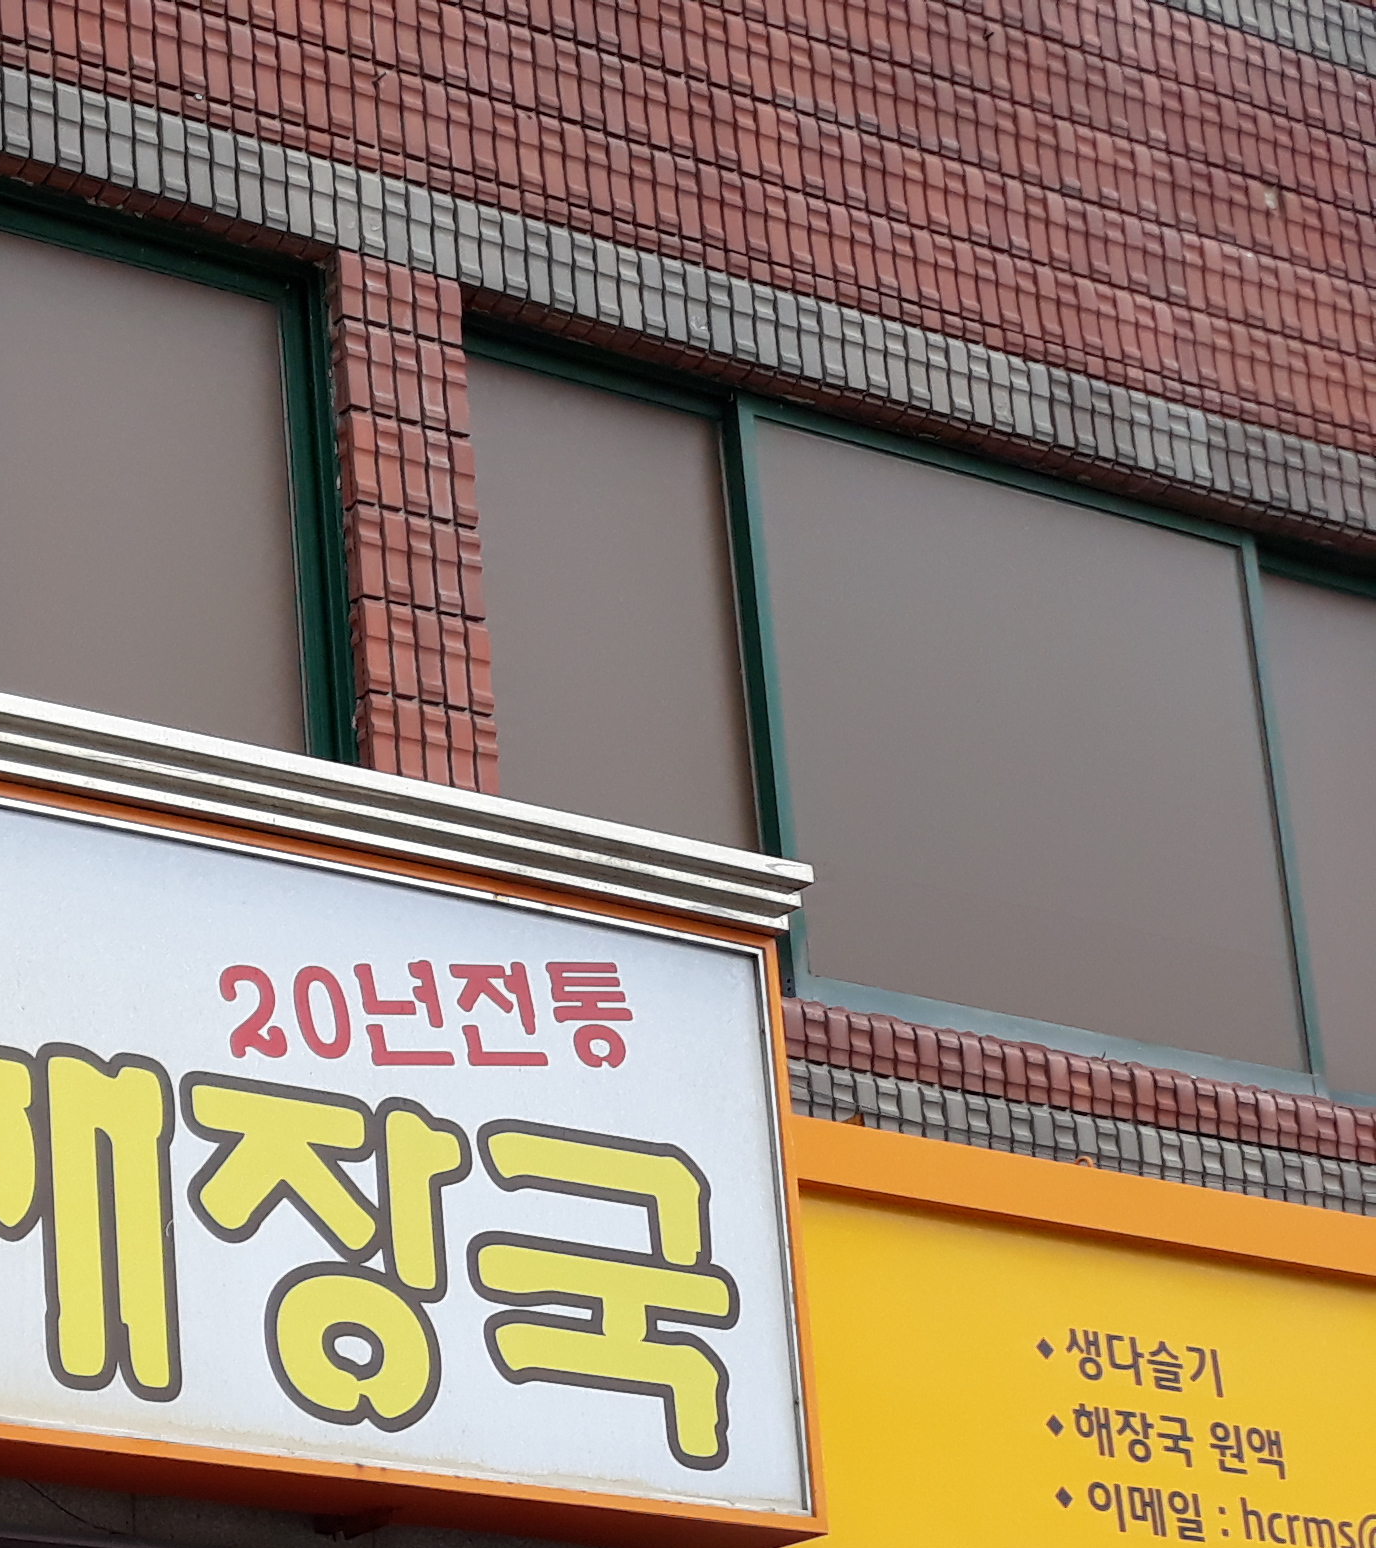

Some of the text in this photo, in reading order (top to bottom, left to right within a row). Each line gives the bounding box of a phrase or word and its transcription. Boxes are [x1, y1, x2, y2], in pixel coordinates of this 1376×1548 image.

[217, 958, 635, 1070] 20년전통
[1065, 1327, 1225, 1399] 생다슬기
[1073, 1403, 1287, 1480] 해장국 원액
[1087, 1481, 1207, 1543] 이메일
